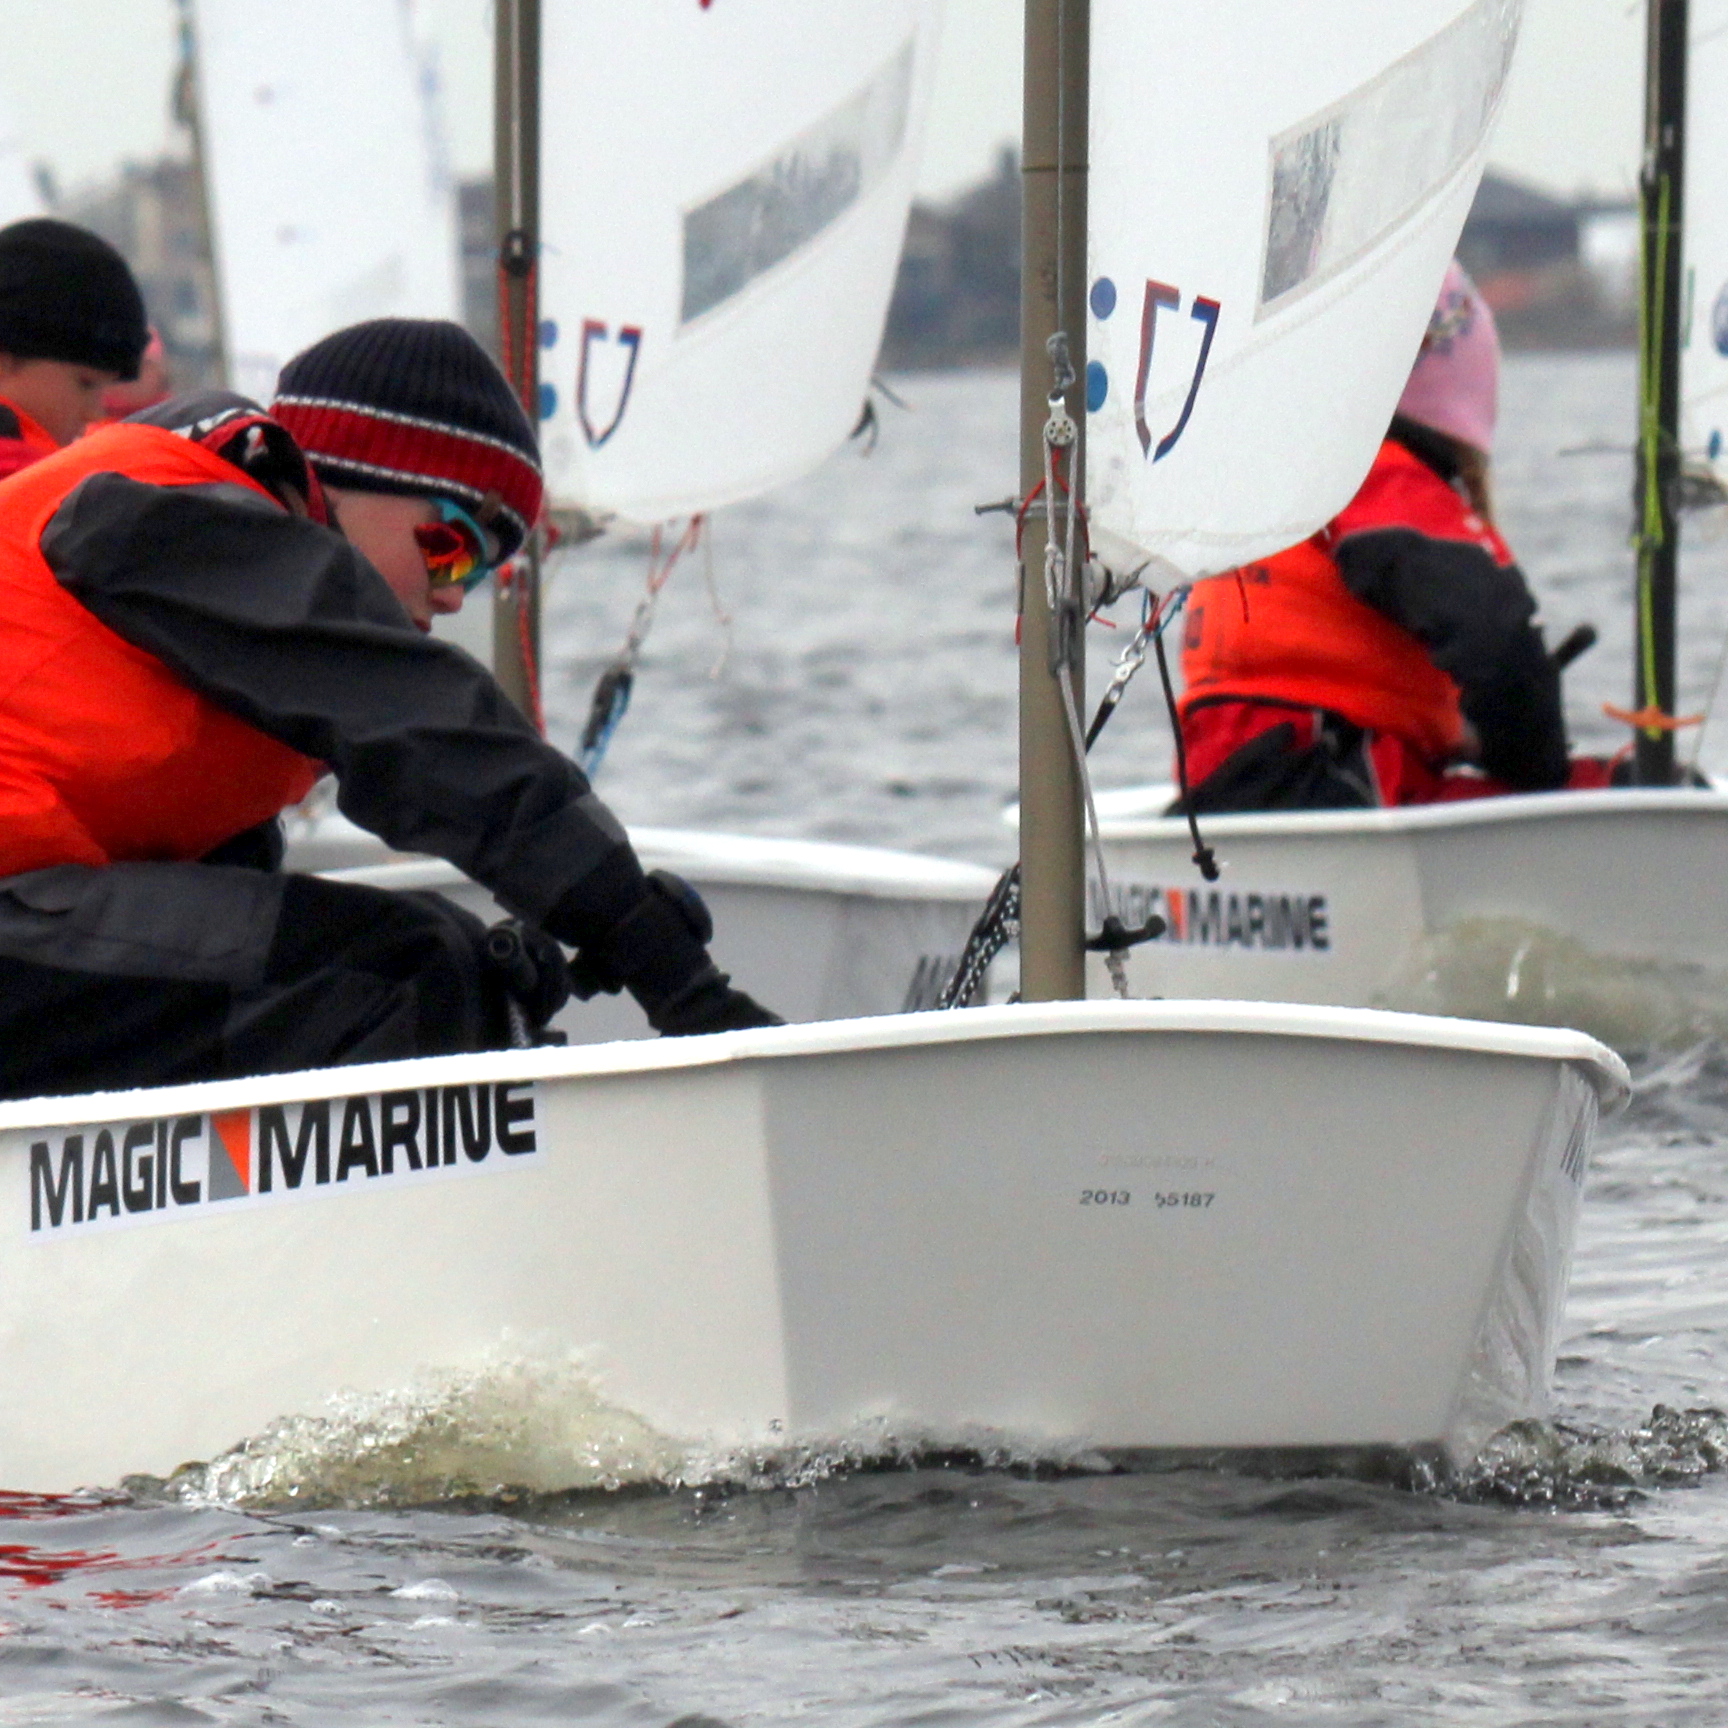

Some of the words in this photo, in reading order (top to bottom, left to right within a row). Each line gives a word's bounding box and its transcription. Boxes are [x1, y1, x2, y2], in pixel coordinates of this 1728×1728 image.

[1187, 888, 1330, 950] MARINE
[30, 1127, 203, 1233] MAGIC
[257, 1083, 538, 1194] MARINE
